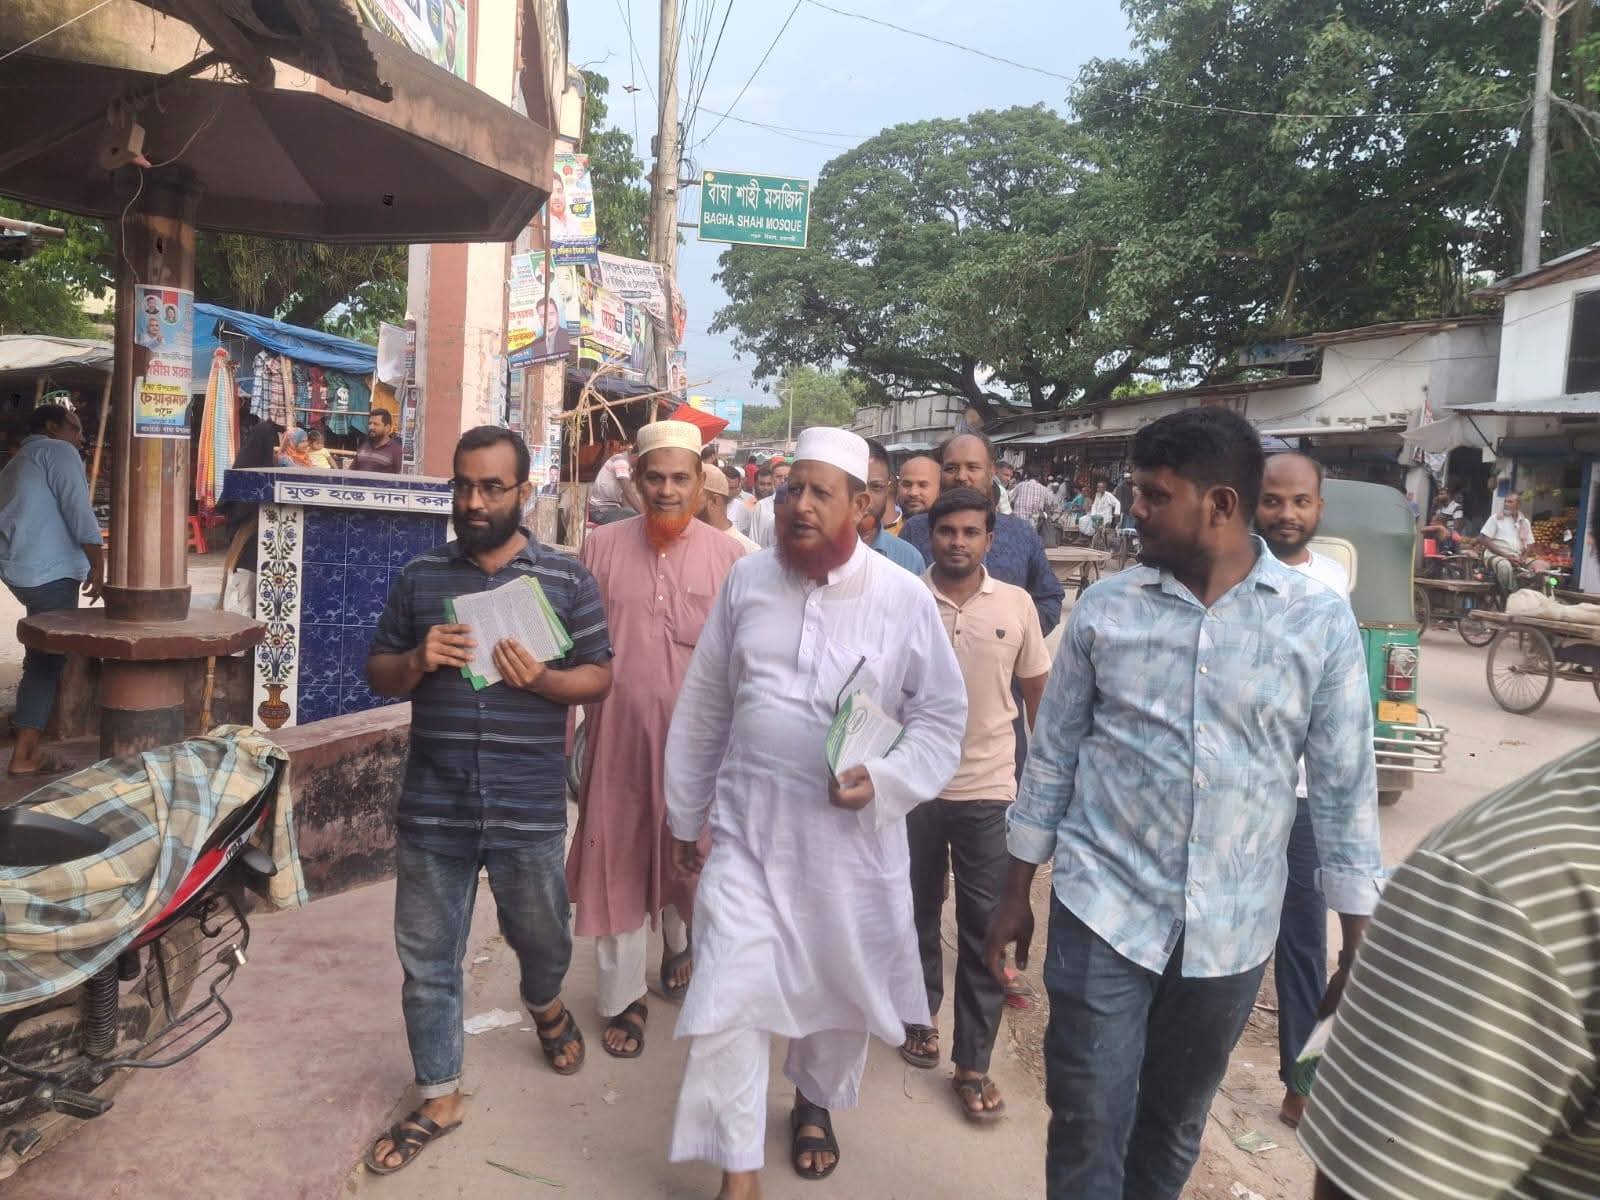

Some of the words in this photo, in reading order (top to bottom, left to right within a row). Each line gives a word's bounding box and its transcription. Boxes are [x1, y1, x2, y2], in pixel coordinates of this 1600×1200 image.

[708, 182, 732, 206] বাঘা
[736, 179, 761, 211] শাহী
[764, 183, 804, 213] মসজিদ
[704, 212, 734, 226] BAGHA
[737, 214, 764, 228] SHAHI
[766, 216, 802, 232] MOSQUE
[141, 392, 188, 406] চেয়ারম্যান
[284, 486, 320, 500] মুক্ত
[328, 488, 366, 502] হস্তে
[374, 491, 407, 505] দান
[415, 495, 454, 507] করু
